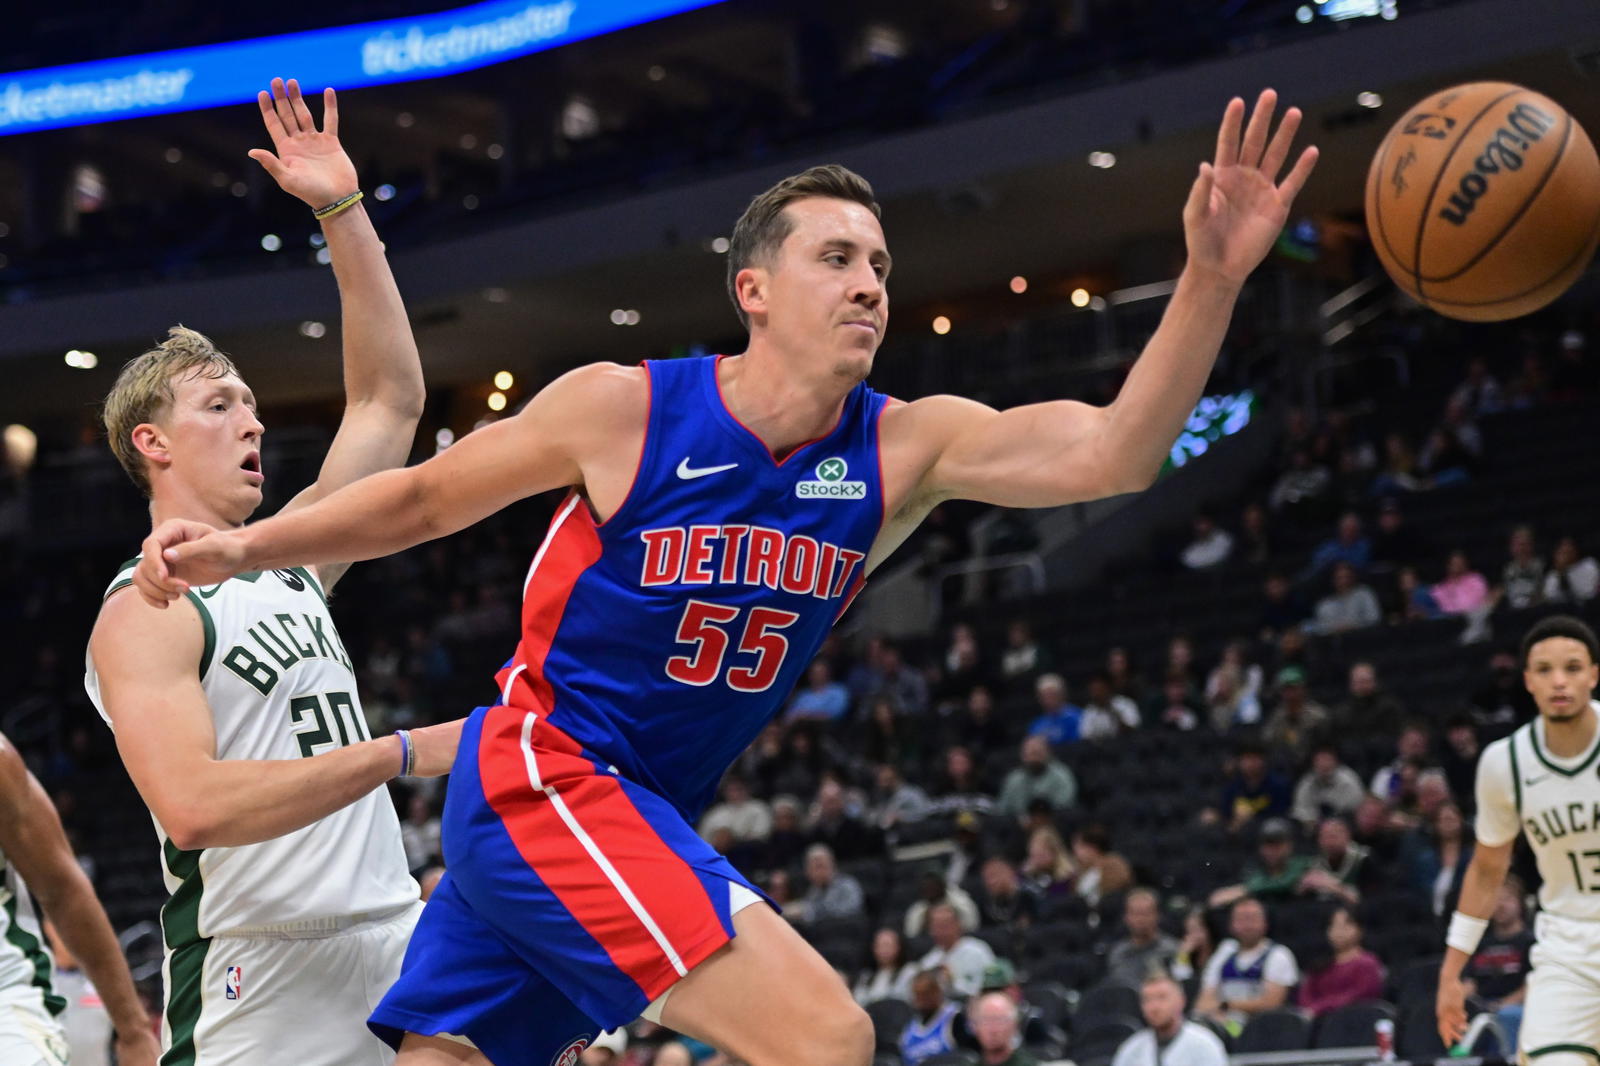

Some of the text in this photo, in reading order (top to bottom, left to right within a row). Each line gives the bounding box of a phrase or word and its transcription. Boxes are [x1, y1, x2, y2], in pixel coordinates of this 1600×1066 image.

[362, 2, 576, 75] ticketmaster
[1439, 103, 1554, 226] Wilson
[799, 483, 864, 496] StockX
[641, 524, 865, 600] DETROIT
[665, 599, 800, 692] 55
